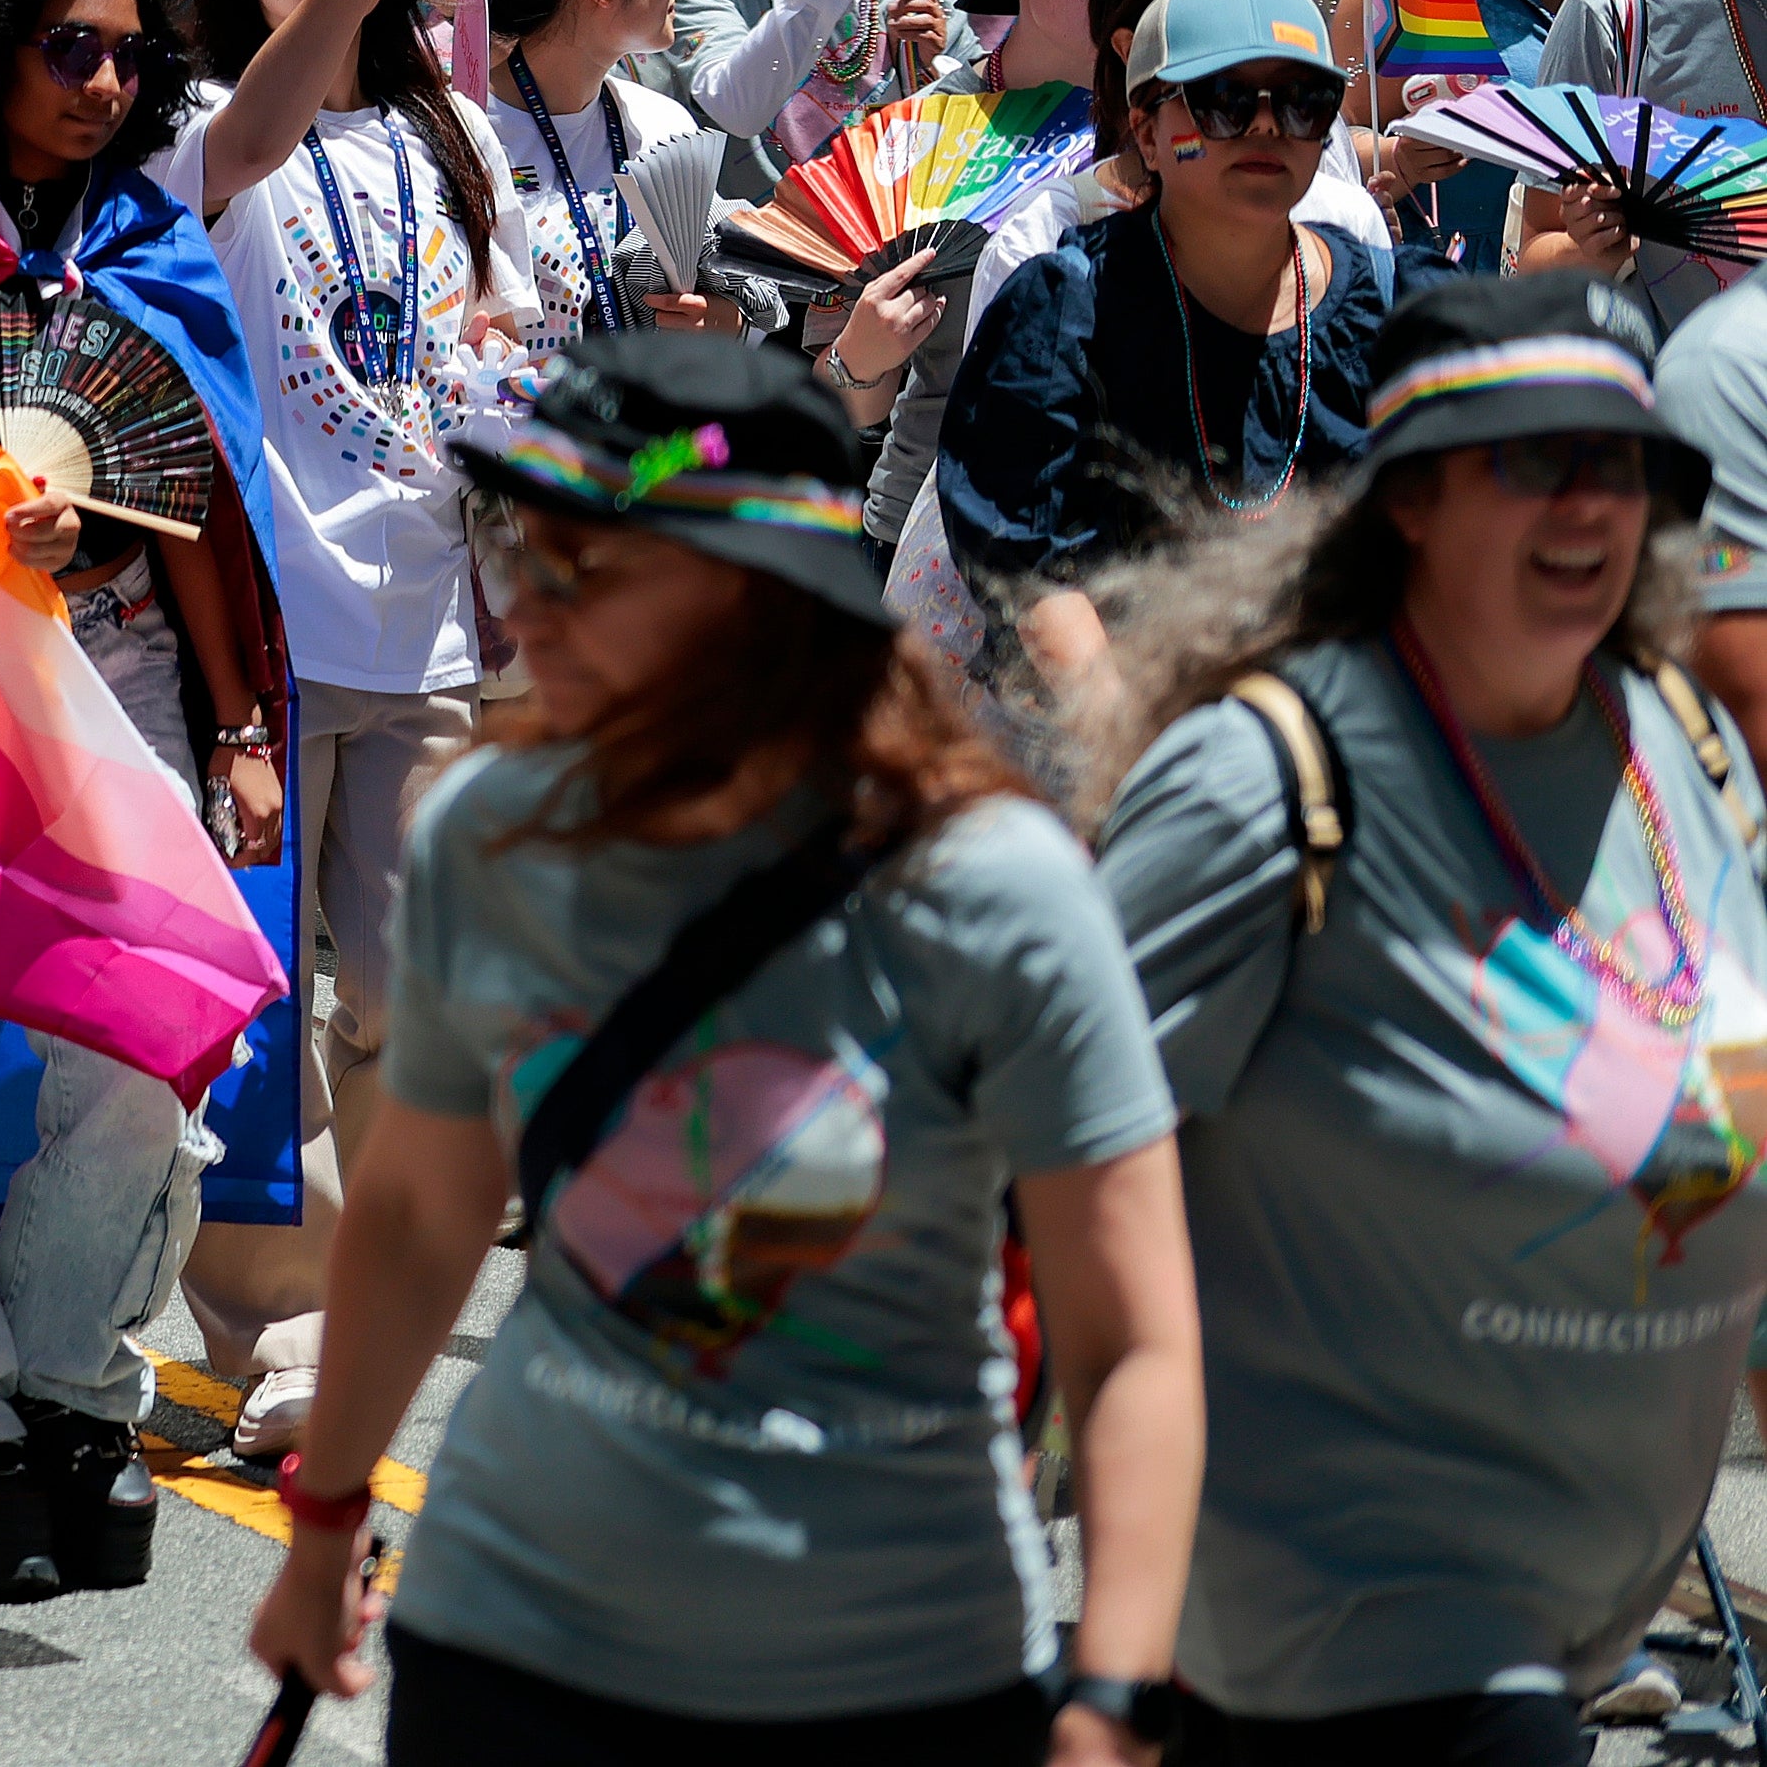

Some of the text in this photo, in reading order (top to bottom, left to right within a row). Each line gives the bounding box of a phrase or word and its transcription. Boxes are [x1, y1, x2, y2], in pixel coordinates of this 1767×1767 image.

[406, 239, 415, 271] PRIDE
[590, 253, 603, 282] PRIDE
[405, 272, 415, 283] IS
[354, 278, 367, 311] PRIDE
[405, 285, 414, 297] IN
[596, 283, 606, 293] IS
[599, 294, 610, 305] IN
[360, 312, 370, 326] SF
[404, 298, 414, 325] OUR
[603, 306, 616, 329] OUR
